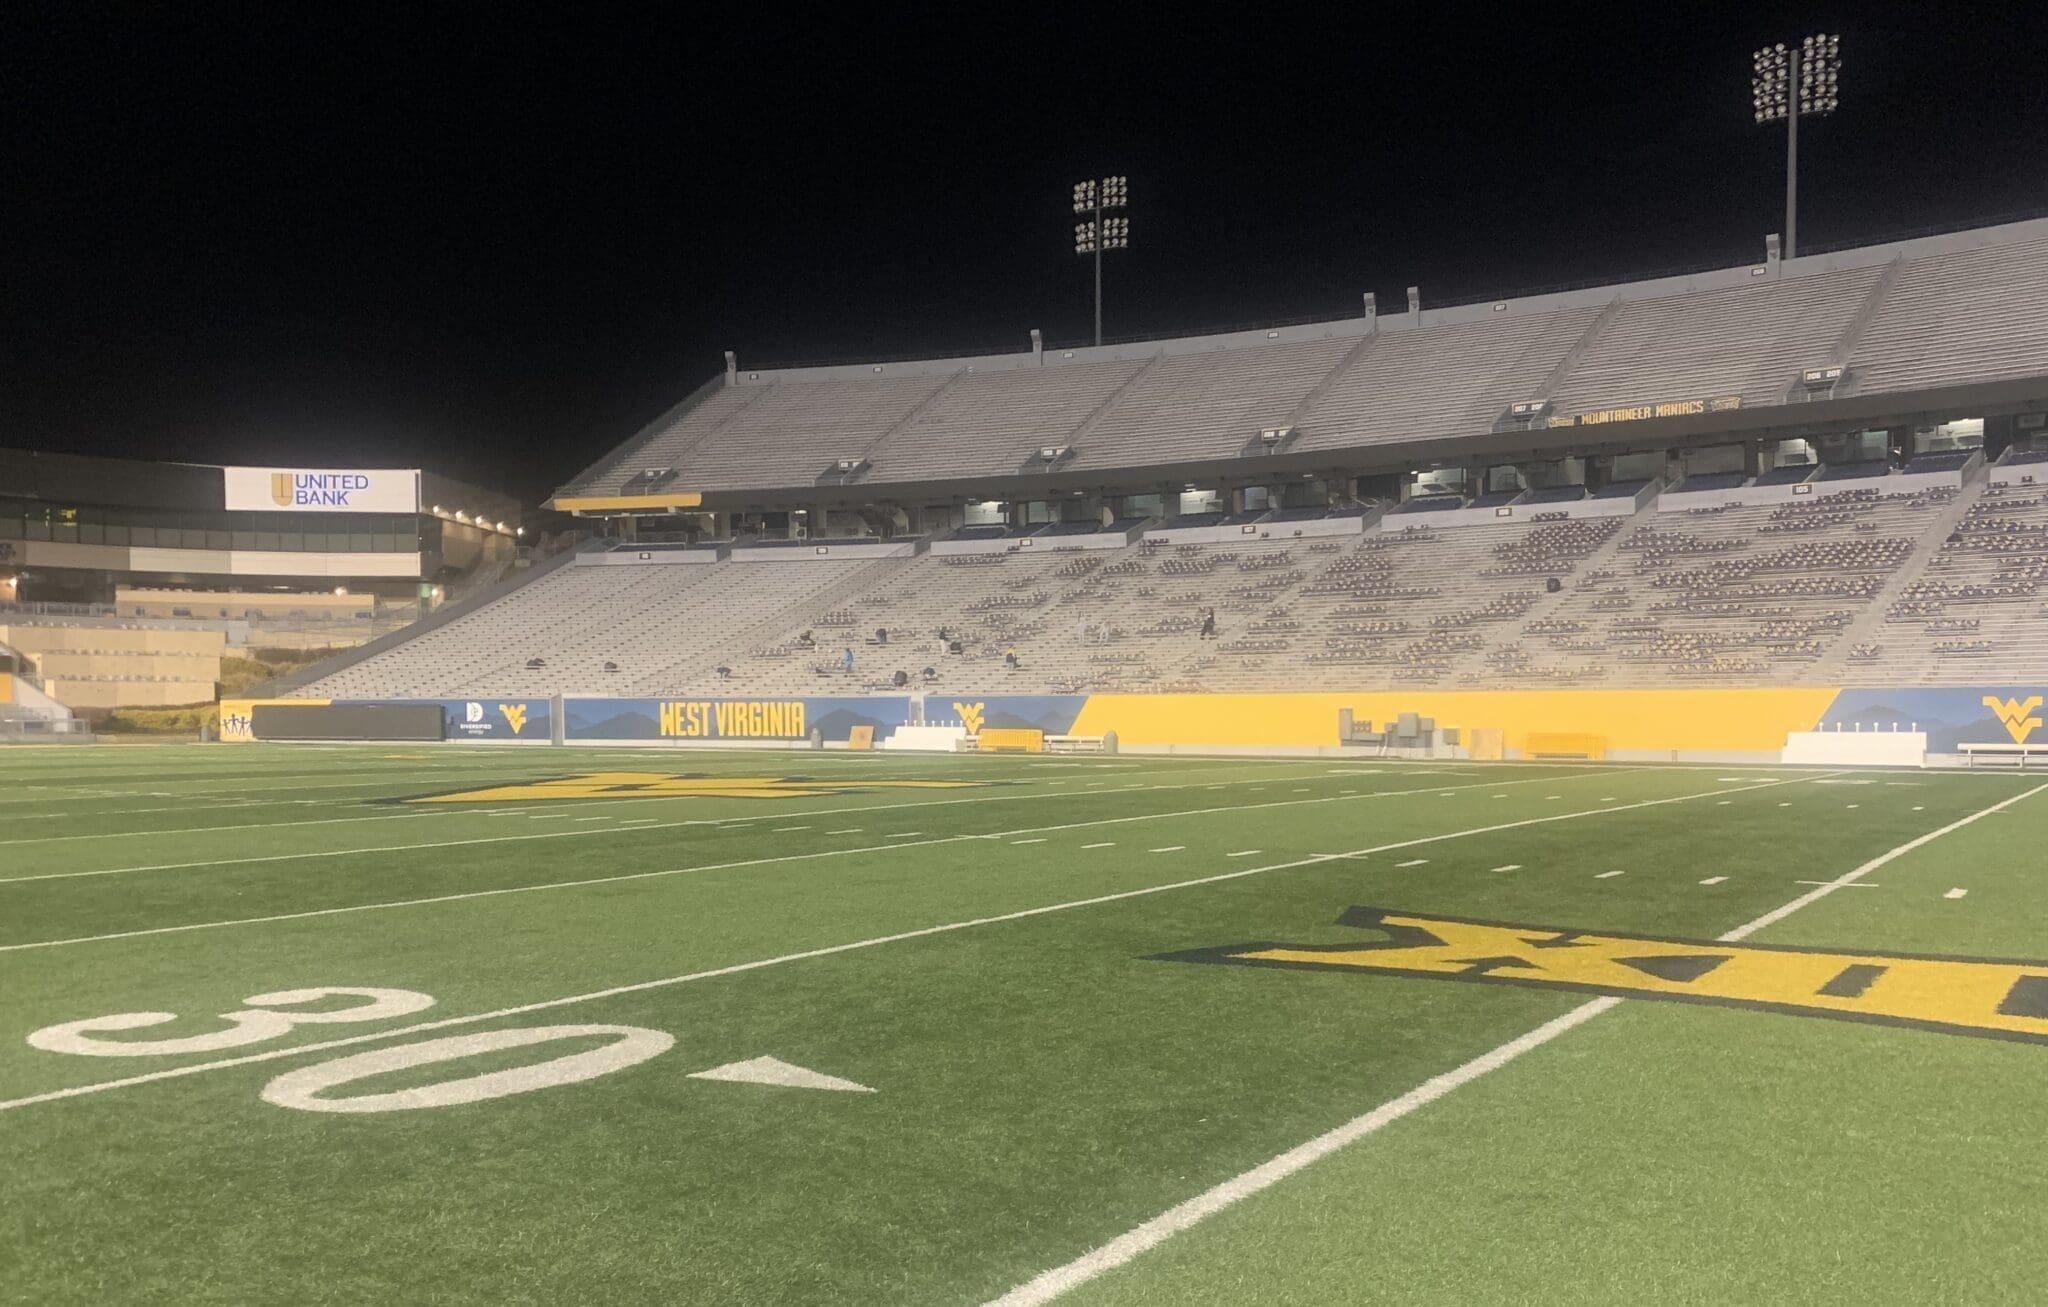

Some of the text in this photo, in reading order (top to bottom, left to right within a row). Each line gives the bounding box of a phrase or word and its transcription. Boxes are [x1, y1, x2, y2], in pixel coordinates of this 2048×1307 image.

[1581, 406, 1651, 425] MOUNTAINEER
[1656, 400, 1704, 417] MANIACS
[295, 474, 369, 490] UNITED
[295, 490, 349, 506] BANK
[660, 702, 805, 737] WEST VIRGINIA
[26, 986, 676, 1113] 30
